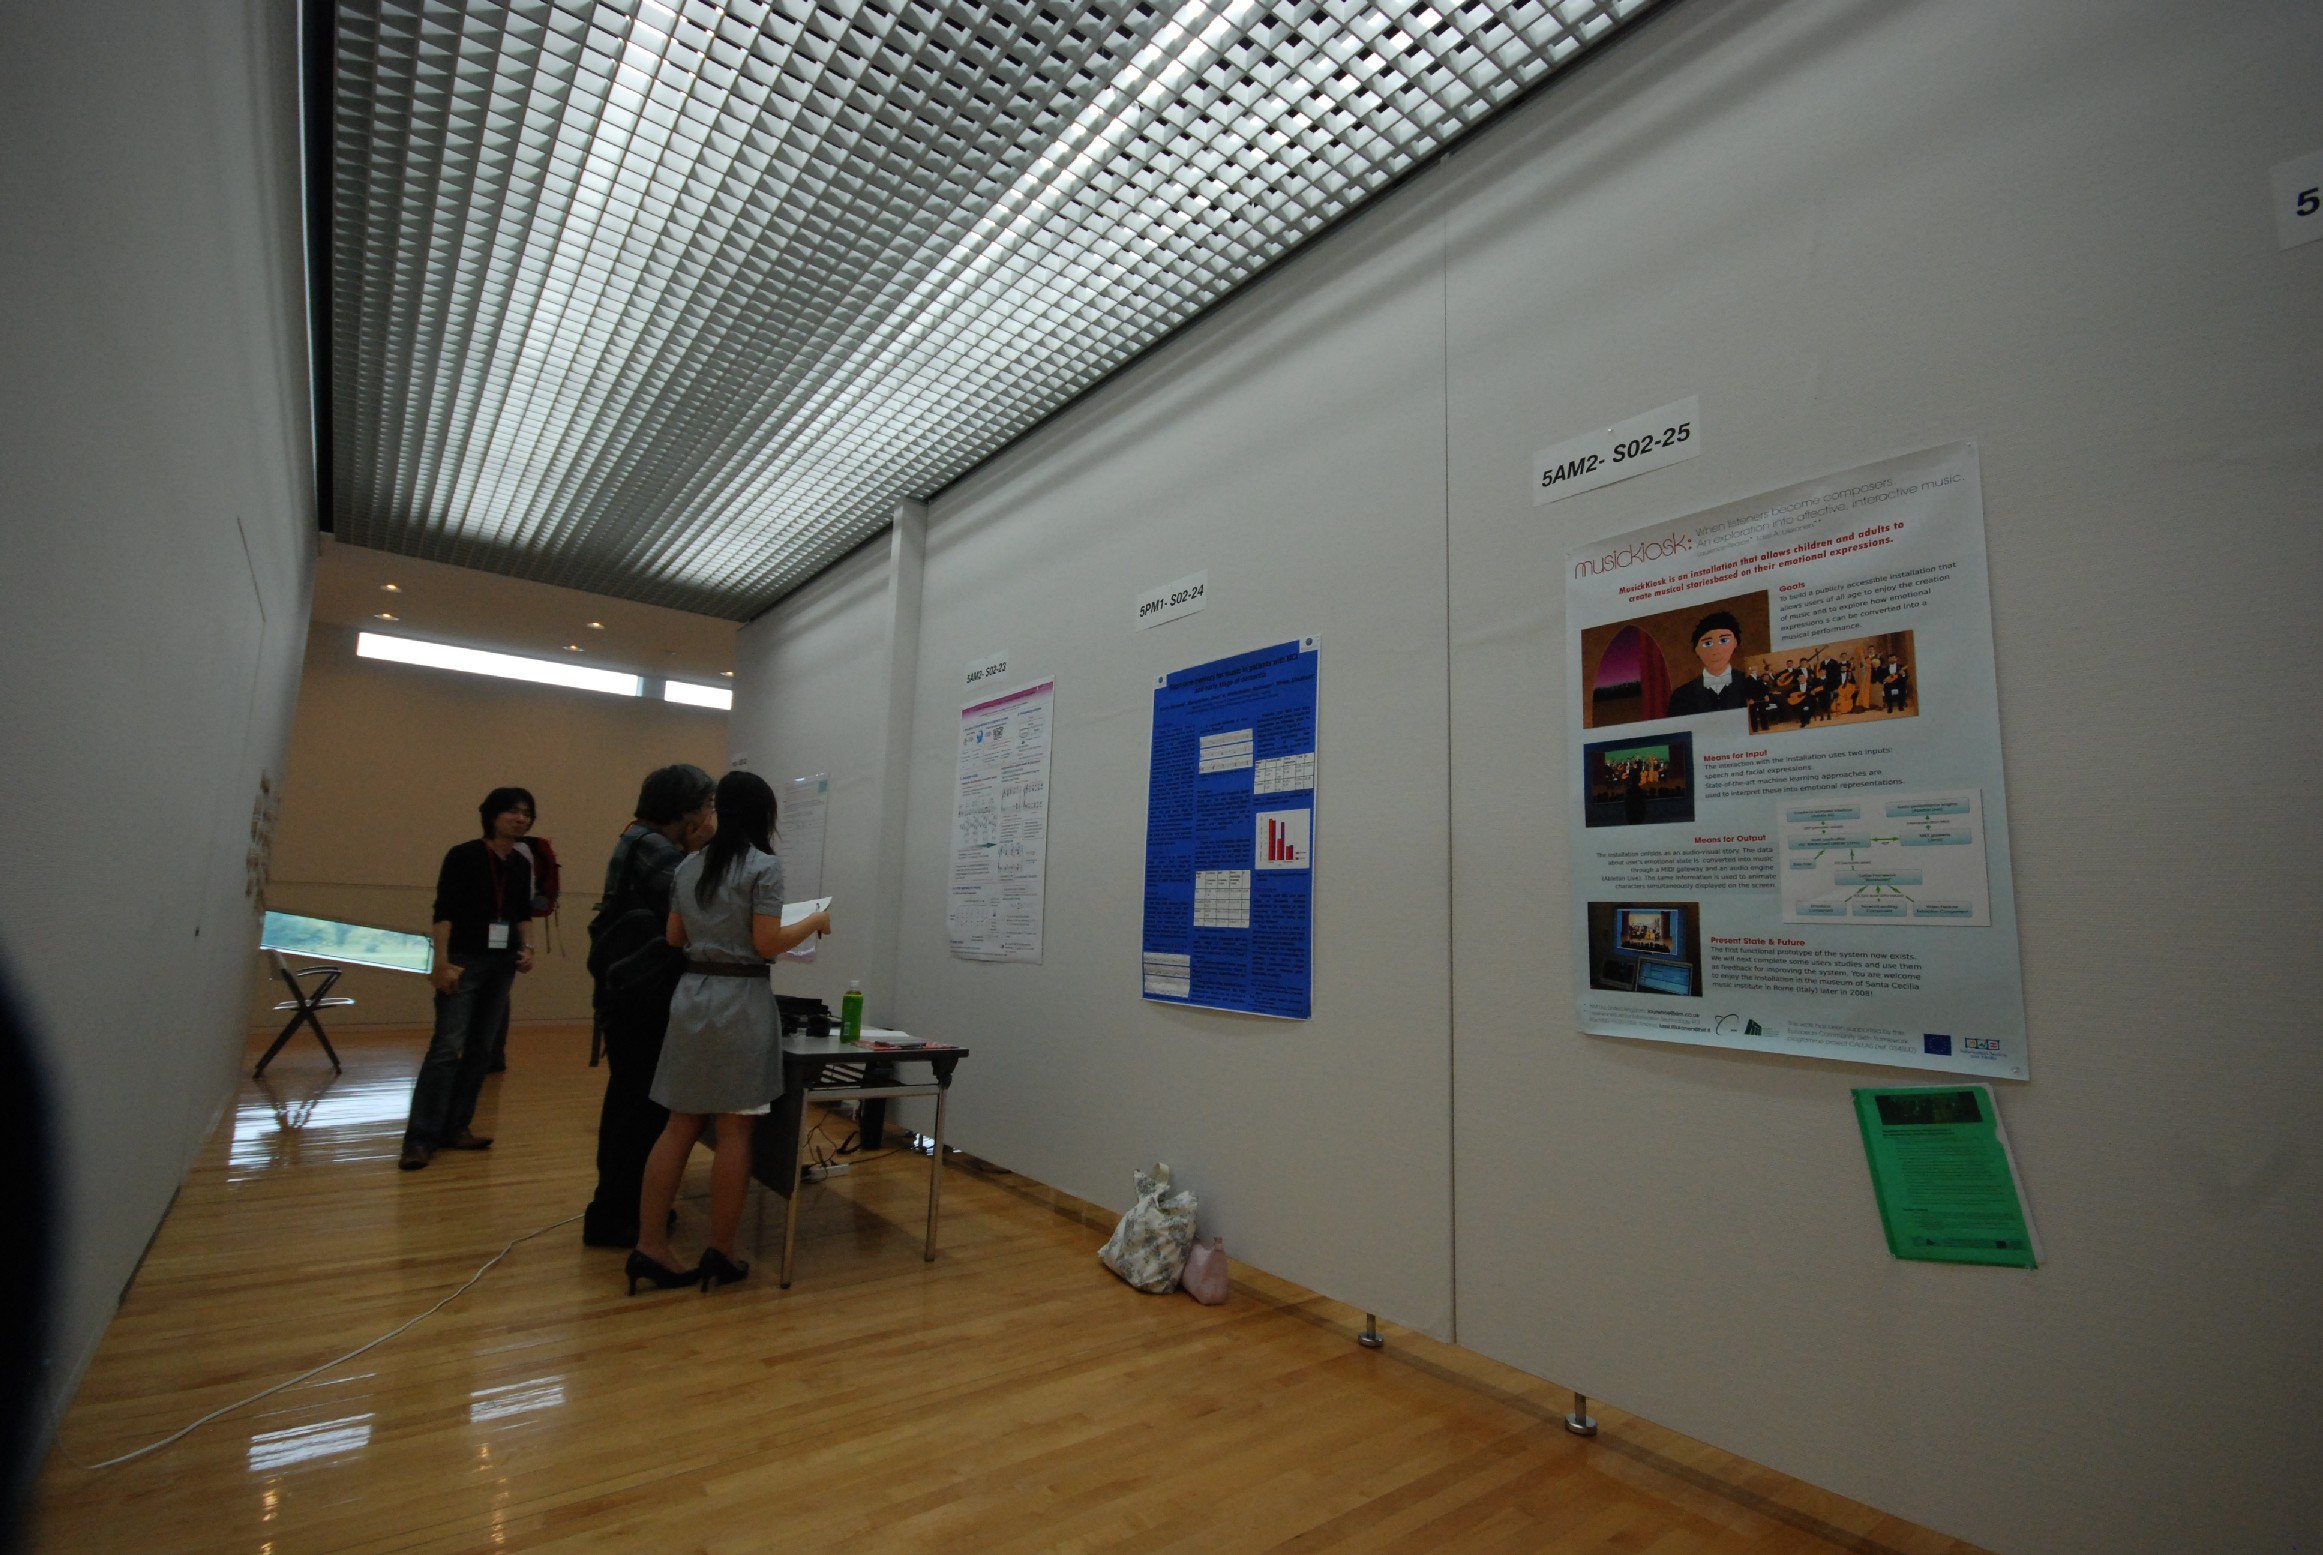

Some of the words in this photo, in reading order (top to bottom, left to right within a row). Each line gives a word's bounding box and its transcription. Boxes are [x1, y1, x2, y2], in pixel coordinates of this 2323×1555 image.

[1542, 454, 1605, 487] 5AM2-
[1612, 422, 1691, 463] S02-25
[1697, 537, 1711, 546] An
[1713, 522, 1770, 542] exploration
[1772, 515, 1793, 527] into
[1852, 487, 1917, 509] interactive
[1922, 475, 1965, 490] music.
[1771, 498, 1820, 515] become
[1669, 573, 1675, 583] is
[1678, 572, 1688, 580] an
[1691, 561, 1737, 578] installation
[1740, 554, 1758, 567] that
[1761, 549, 1791, 562] allows
[1794, 539, 1832, 554] children
[1836, 532, 1854, 544] and
[1858, 525, 1890, 539] adults
[1894, 521, 1904, 531] to
[1629, 589, 1652, 602] create
[1654, 580, 1684, 596] musical
[1686, 568, 1737, 588] storiesbased
[1742, 569, 1751, 577] on
[1754, 561, 1775, 574] their
[1779, 549, 1826, 568] emotional
[1830, 537, 1894, 557] expressions.
[1779, 582, 1805, 592] Goals
[1789, 591, 1807, 600] build
[1815, 584, 1844, 597] publicly
[1847, 575, 1887, 589] accessible
[1890, 567, 1936, 581] installation
[1938, 561, 1957, 571] that
[1140, 599, 1167, 617] 5PM1-
[1170, 584, 1204, 606] S02-24
[1780, 603, 1802, 611] allows
[1805, 599, 1824, 607] users
[1826, 595, 1834, 603] of
[1836, 593, 1845, 601] all
[1847, 592, 1862, 600] age
[1864, 588, 1872, 596] to
[1875, 585, 1896, 594] enjoy
[1899, 581, 1912, 589] the
[1915, 575, 1949, 586] creation
[1781, 613, 1788, 621] of
[1790, 610, 1810, 619] music
[1813, 606, 1827, 615] and
[1829, 605, 1836, 613] to
[1839, 601, 1868, 611] explore
[1871, 597, 1887, 605] how
[1889, 587, 1931, 601] emotional
[1860, 603, 1901, 617] converted
[1904, 601, 1919, 610] into
[1781, 629, 1809, 640] musical
[1719, 760, 1754, 769] interaction
[1756, 757, 1770, 765] with
[1786, 753, 1826, 763] installation
[1746, 750, 1767, 759] Input
[1705, 771, 1728, 781] speech
[1731, 769, 1743, 777] and
[1746, 767, 1764, 776] facial
[1758, 776, 1787, 784] machine
[1790, 774, 1819, 782] learning
[1822, 770, 1866, 781] approaches
[1705, 790, 1720, 798] used
[1731, 787, 1760, 797] interpret
[1800, 782, 1837, 791] emotional
[1737, 835, 1766, 843] Output
[1743, 938, 1766, 946] State
[1740, 947, 1775, 955] functional
[1777, 949, 1812, 958] prototype
[1839, 951, 1868, 960] system
[1835, 960, 1862, 968] studies
[1900, 962, 1922, 970] them
[1884, 972, 1921, 980] welcome
[1866, 980, 1889, 988] Santa
[1892, 982, 1919, 990] Cecilia
